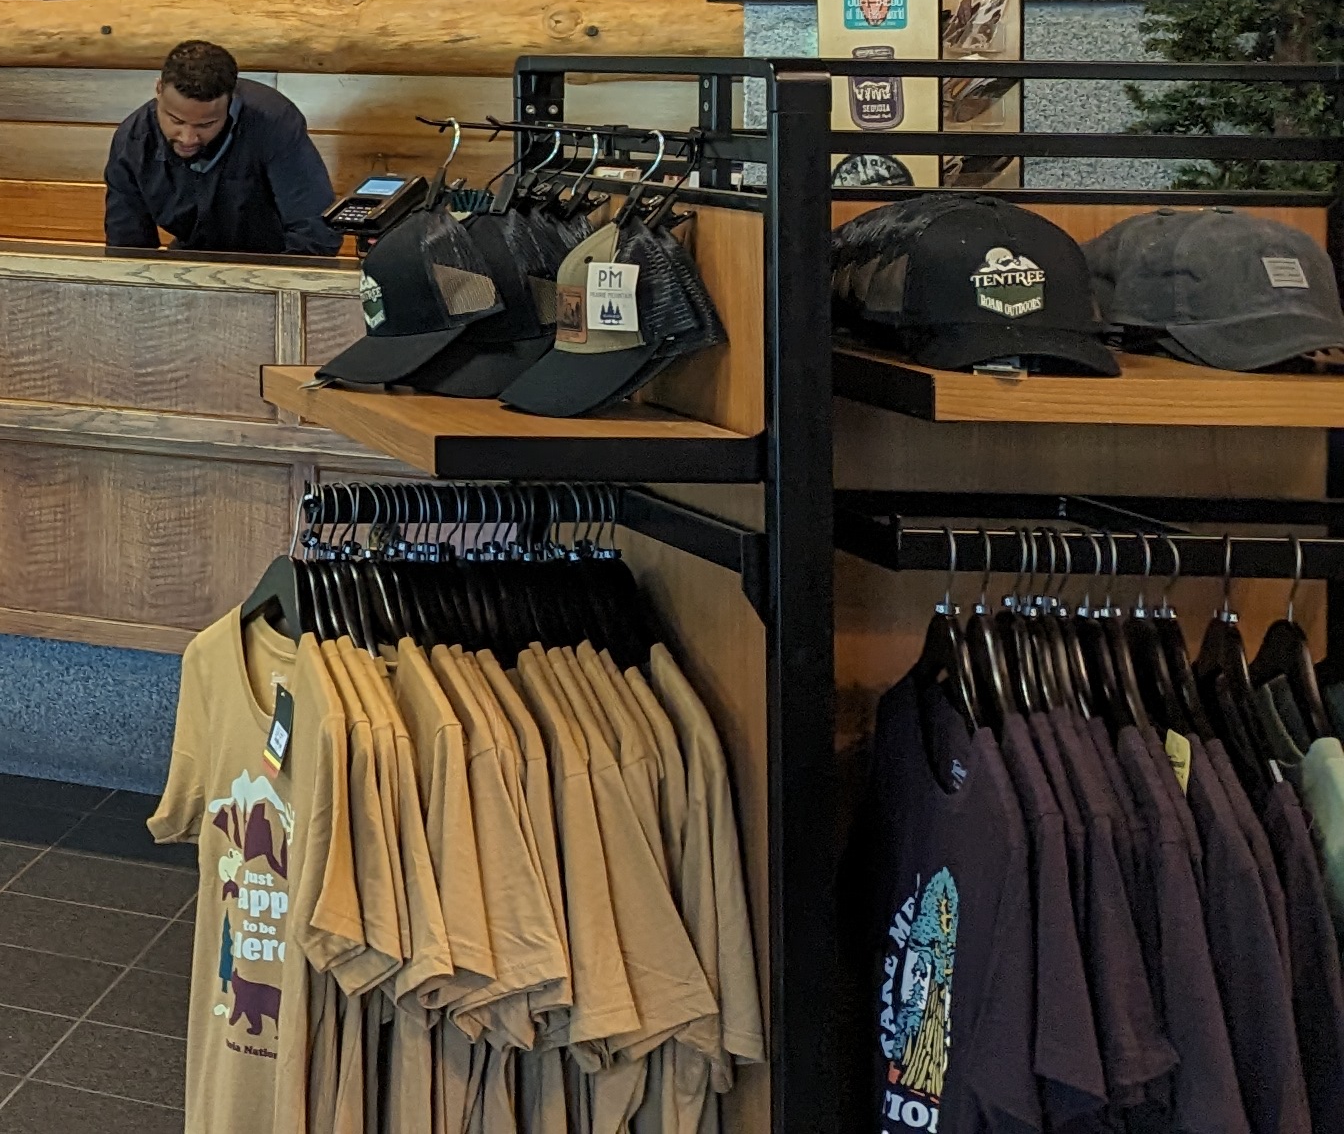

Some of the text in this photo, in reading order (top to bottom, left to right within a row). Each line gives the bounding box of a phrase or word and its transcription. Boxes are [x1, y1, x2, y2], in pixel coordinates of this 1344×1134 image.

[598, 269, 623, 288] PM
[970, 270, 1046, 287] TENTREE
[980, 294, 1003, 313] ROAM
[243, 920, 276, 935] to be
